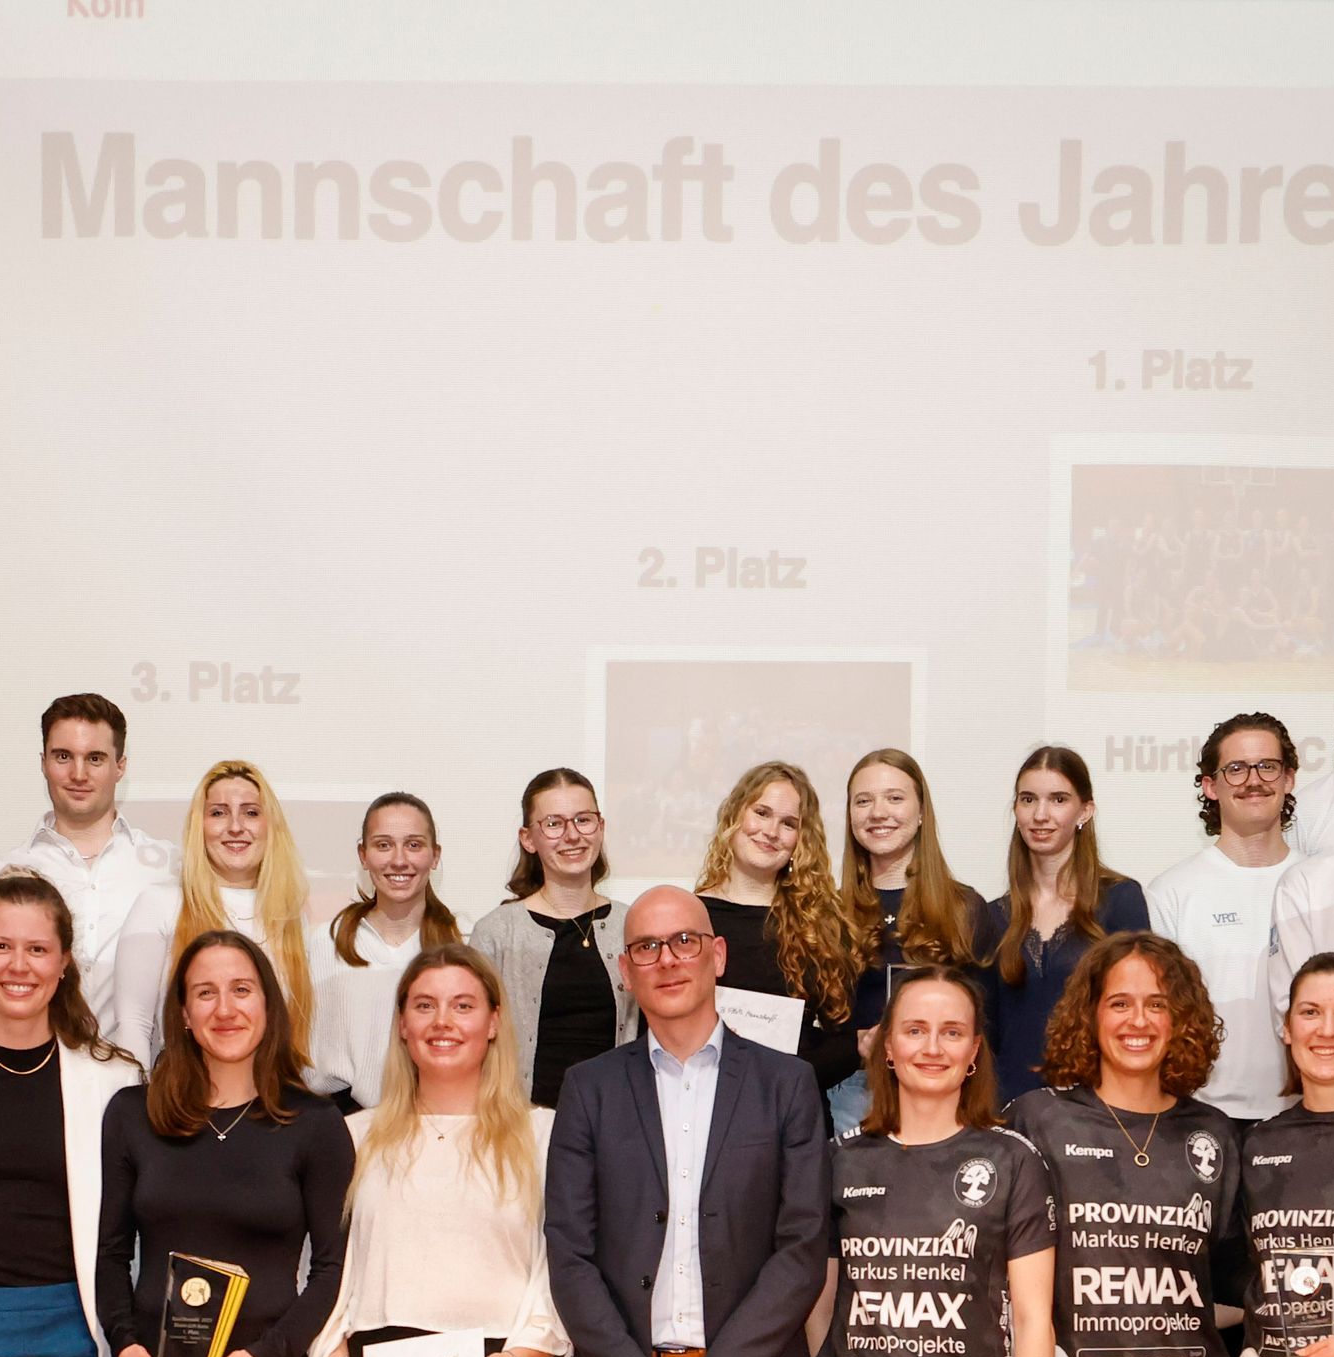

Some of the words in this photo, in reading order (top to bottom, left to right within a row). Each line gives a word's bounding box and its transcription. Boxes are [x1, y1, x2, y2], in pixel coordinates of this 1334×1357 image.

[40, 130, 734, 244] Mannschaft
[769, 137, 981, 246] des
[1087, 349, 1127, 391] 1.
[1142, 348, 1254, 391] Platz
[637, 547, 678, 588] 2.
[695, 546, 807, 589] Platz
[131, 661, 171, 704] 3.
[188, 661, 301, 704] Platz
[1212, 911, 1238, 924] VRT
[1064, 1143, 1114, 1159] Kempa
[1252, 1155, 1293, 1167] Kempa
[843, 1186, 886, 1199] Kempa
[1069, 1202, 1209, 1233] PROVINZIAL
[841, 1236, 970, 1259] PROVINZIAL
[1072, 1230, 1139, 1249] Markus
[1145, 1231, 1204, 1255] Henkel
[847, 1262, 899, 1281] arkus
[903, 1263, 966, 1282] Henkel
[1072, 1266, 1205, 1308] REMAX
[1073, 1312, 1201, 1336] Immoprojekte
[847, 1332, 966, 1357] Immoprojekte
